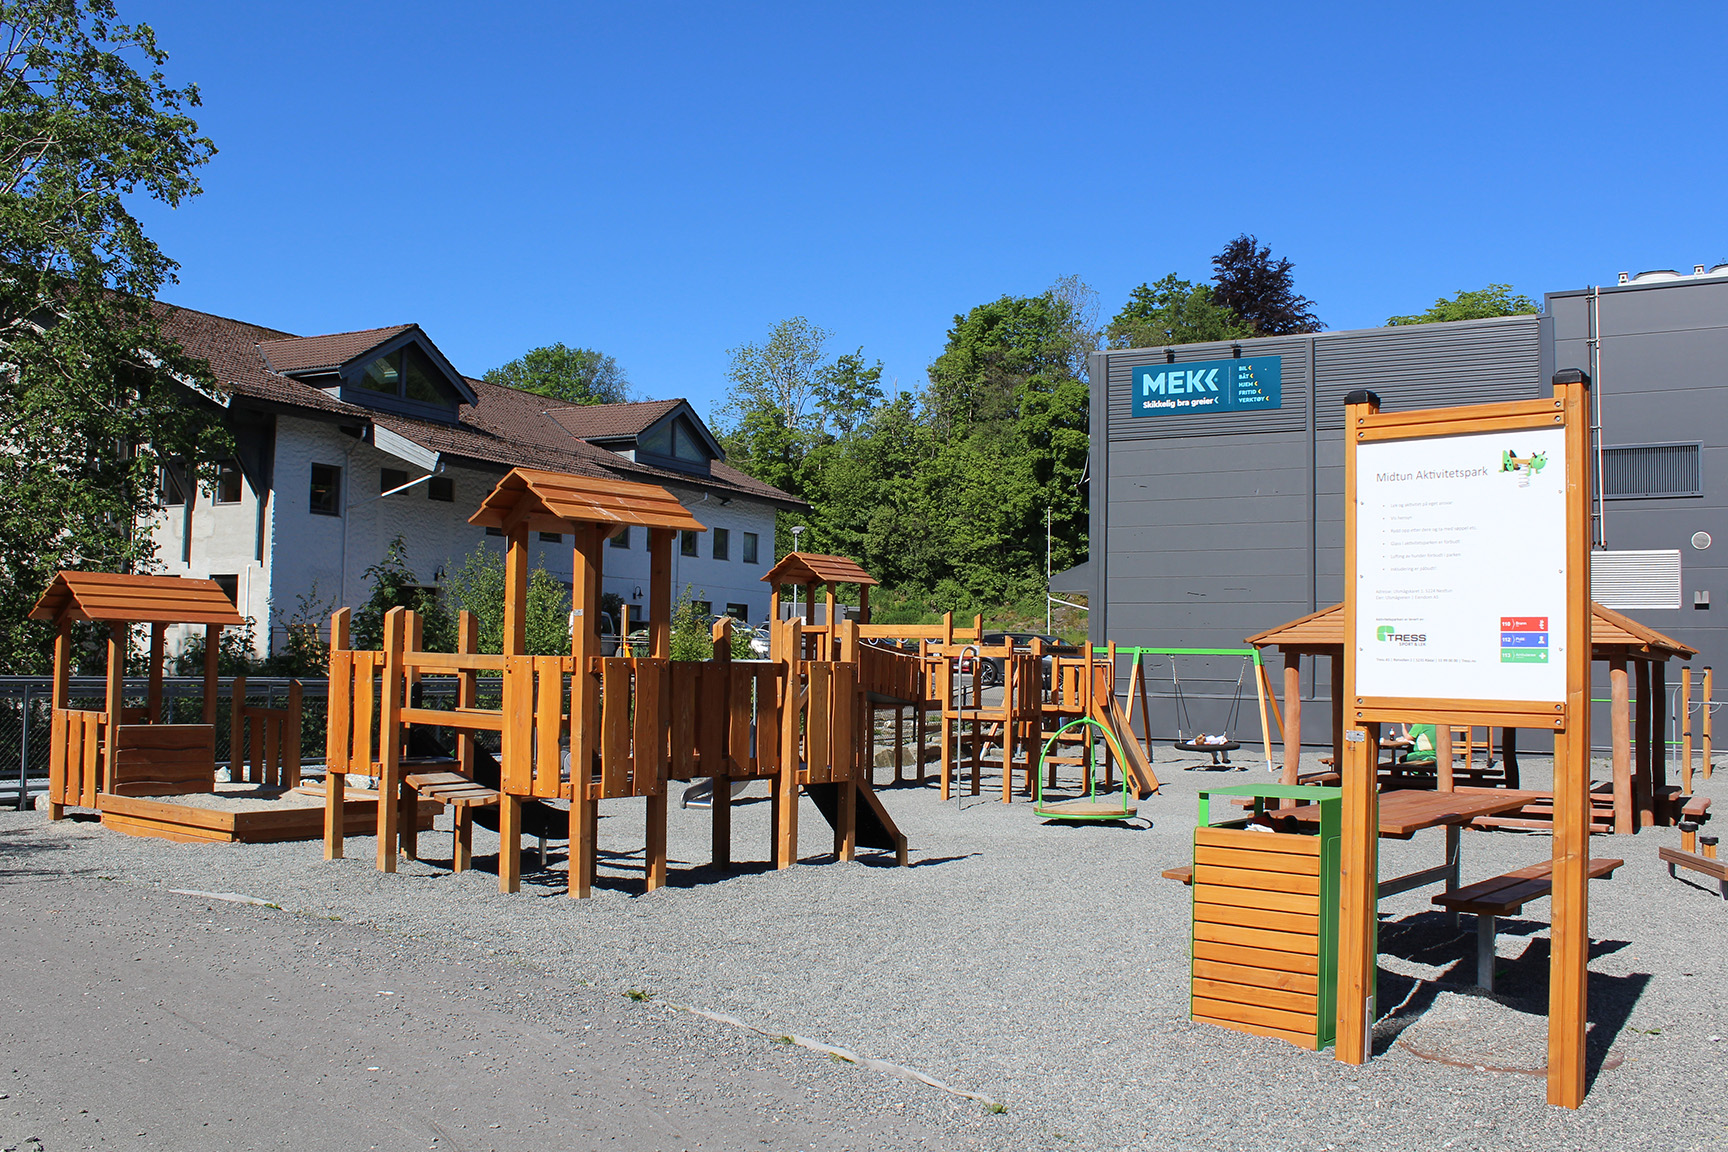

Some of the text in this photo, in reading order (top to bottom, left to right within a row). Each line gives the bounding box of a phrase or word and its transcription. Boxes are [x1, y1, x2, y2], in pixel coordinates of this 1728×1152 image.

[1142, 397, 1214, 409] Skikkelig bra greier
[1376, 466, 1488, 482] Midtun Aktivitetspark
[1387, 634, 1427, 642] TRESS
